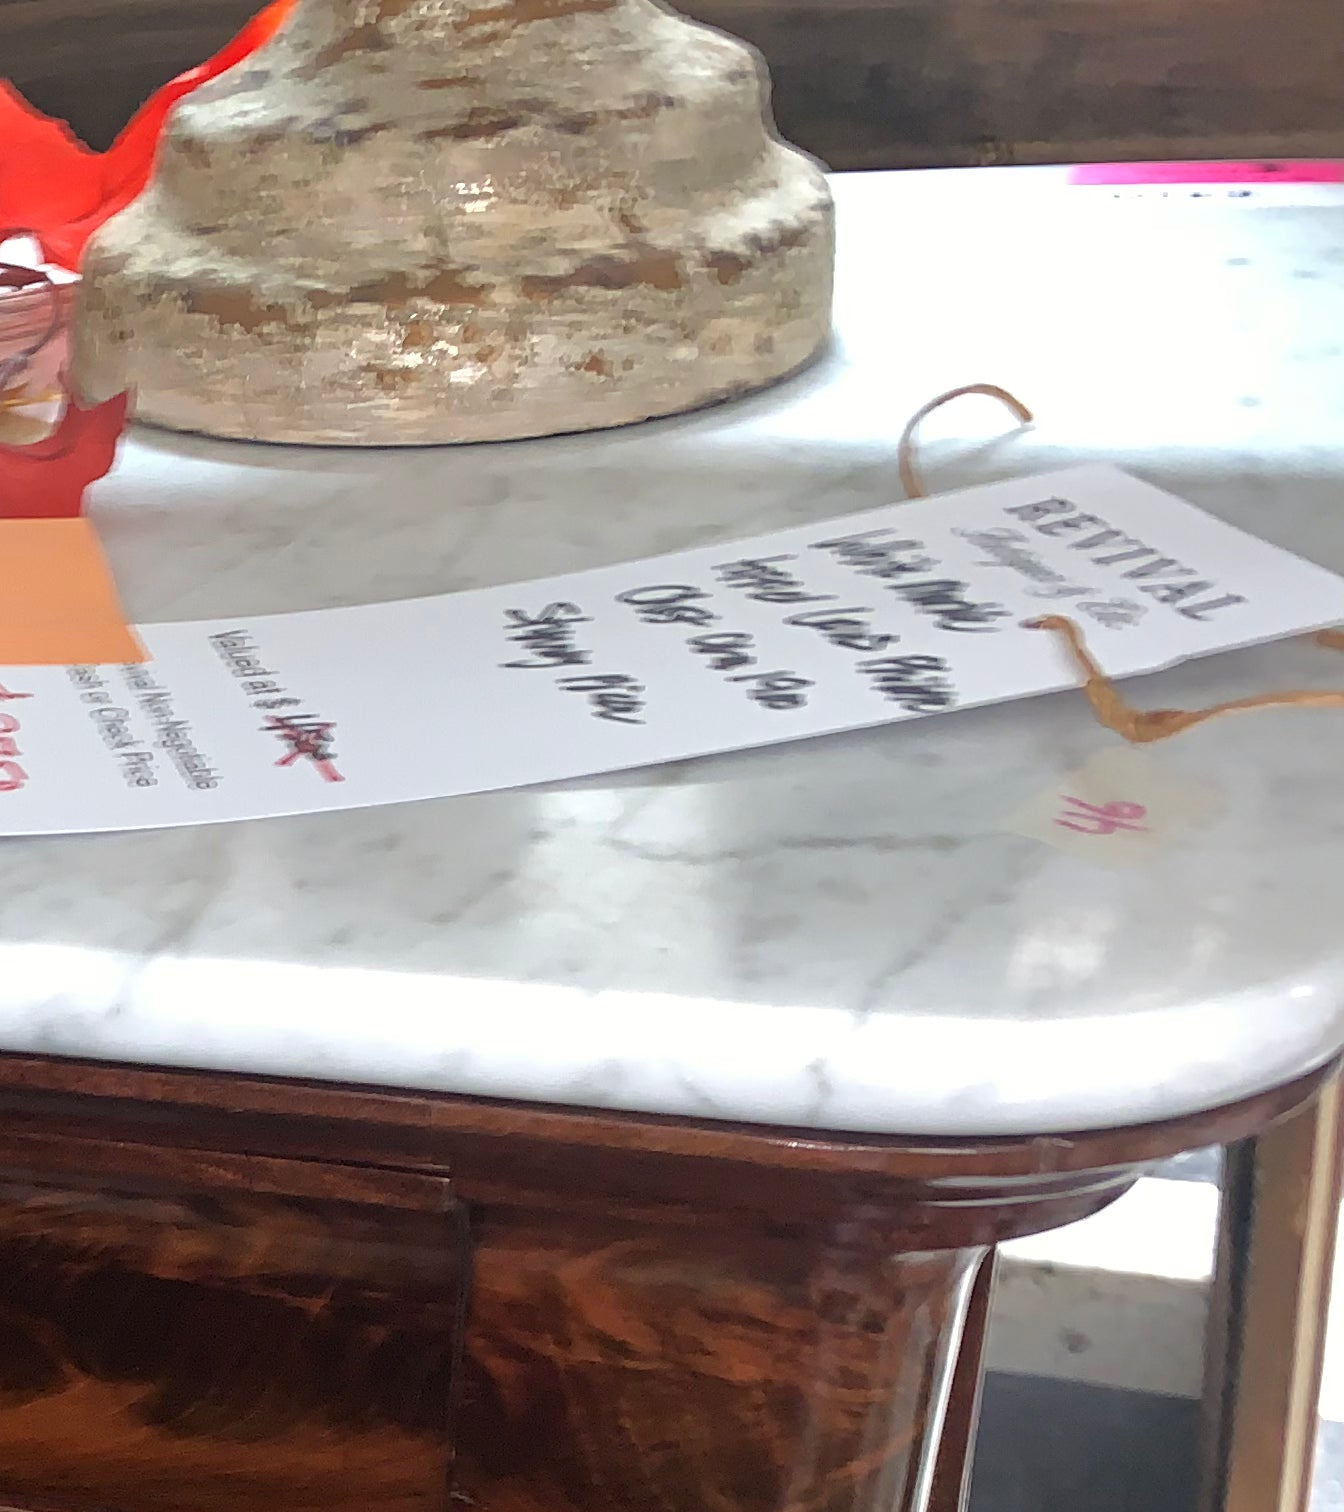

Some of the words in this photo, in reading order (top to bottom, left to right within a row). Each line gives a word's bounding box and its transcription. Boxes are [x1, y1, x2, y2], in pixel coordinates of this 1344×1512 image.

[1003, 497, 1247, 622] REVIVAL
[208, 629, 280, 678] Valued
[241, 680, 288, 696] at
[65, 663, 109, 689] ash
[114, 751, 158, 788] Price
